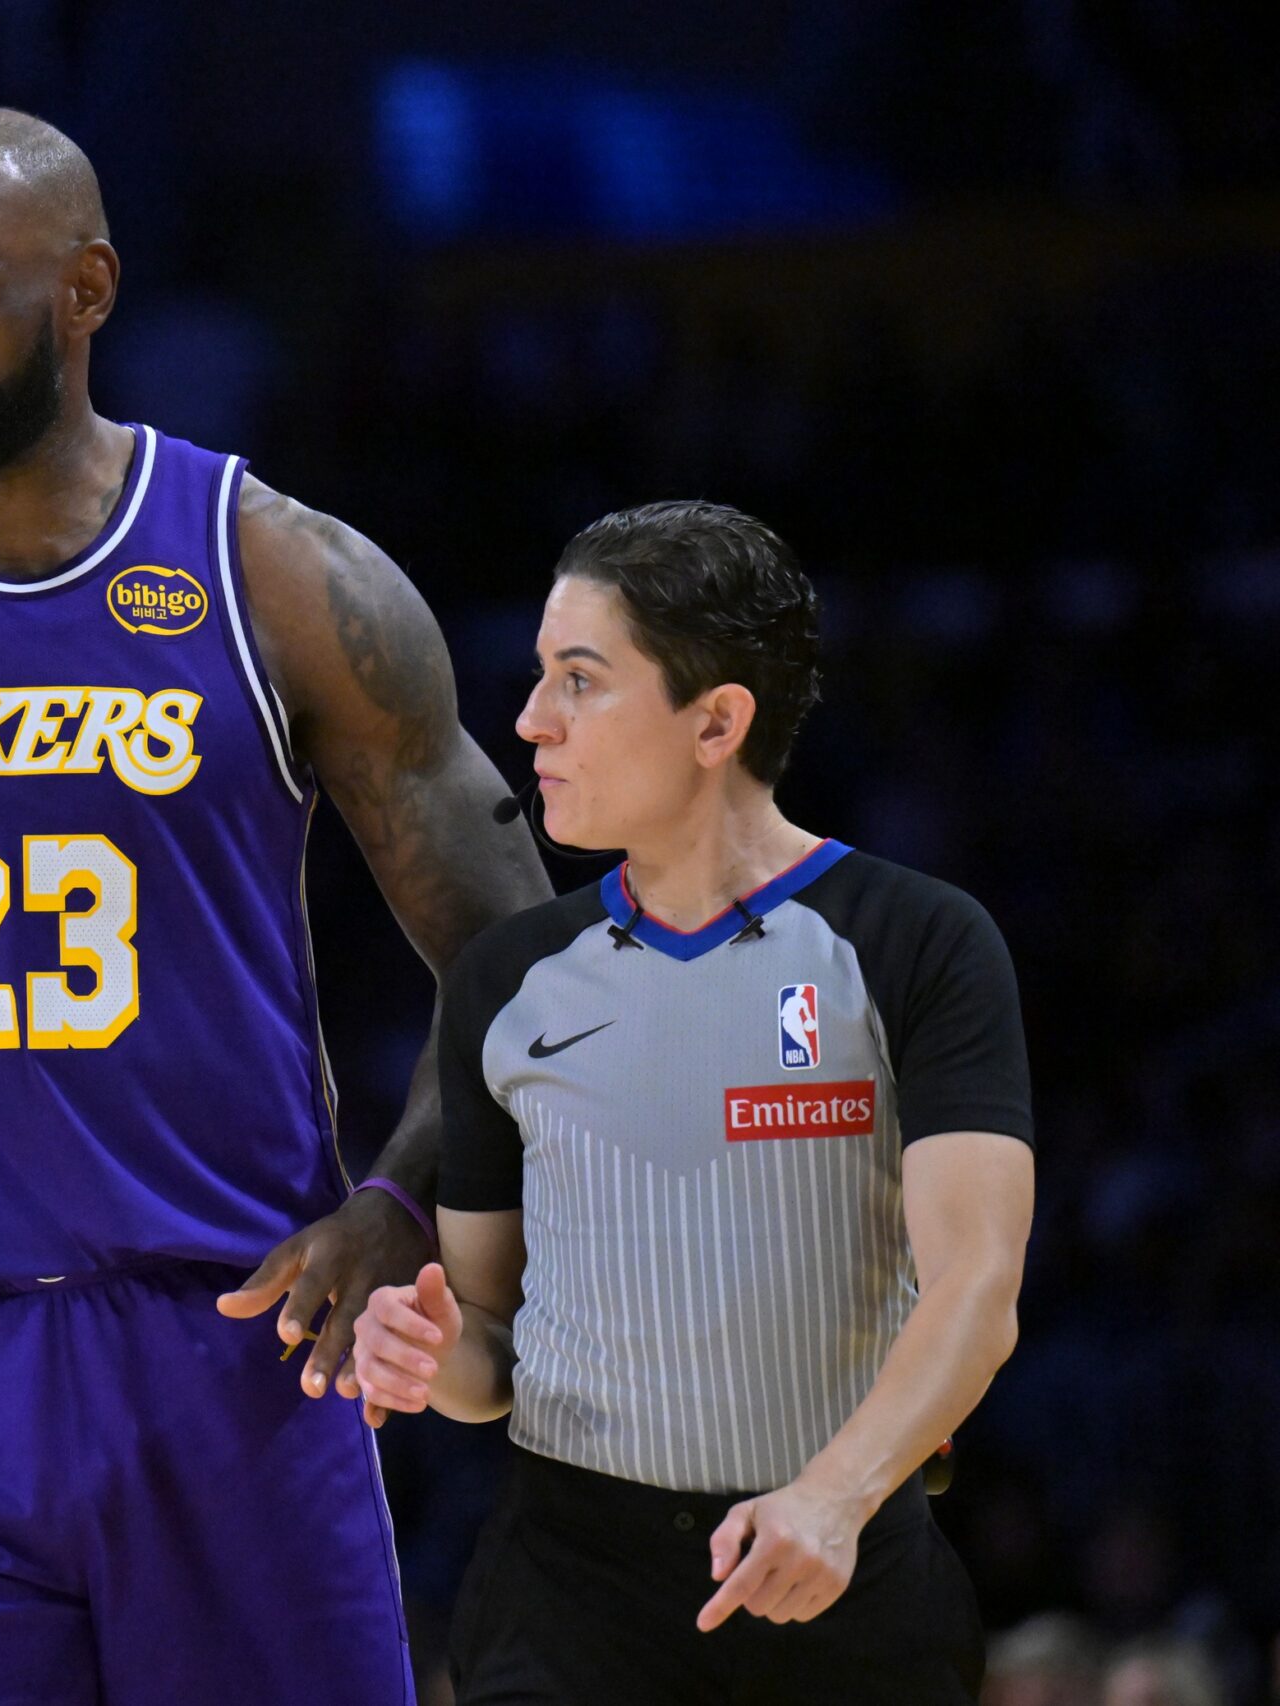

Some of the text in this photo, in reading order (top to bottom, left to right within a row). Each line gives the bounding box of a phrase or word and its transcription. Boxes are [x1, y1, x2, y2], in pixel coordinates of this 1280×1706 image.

[117, 582, 201, 616] bibigo
[132, 607, 168, 620] 비비고
[785, 1049, 805, 1064] NBA
[730, 1095, 870, 1128] Emirates
